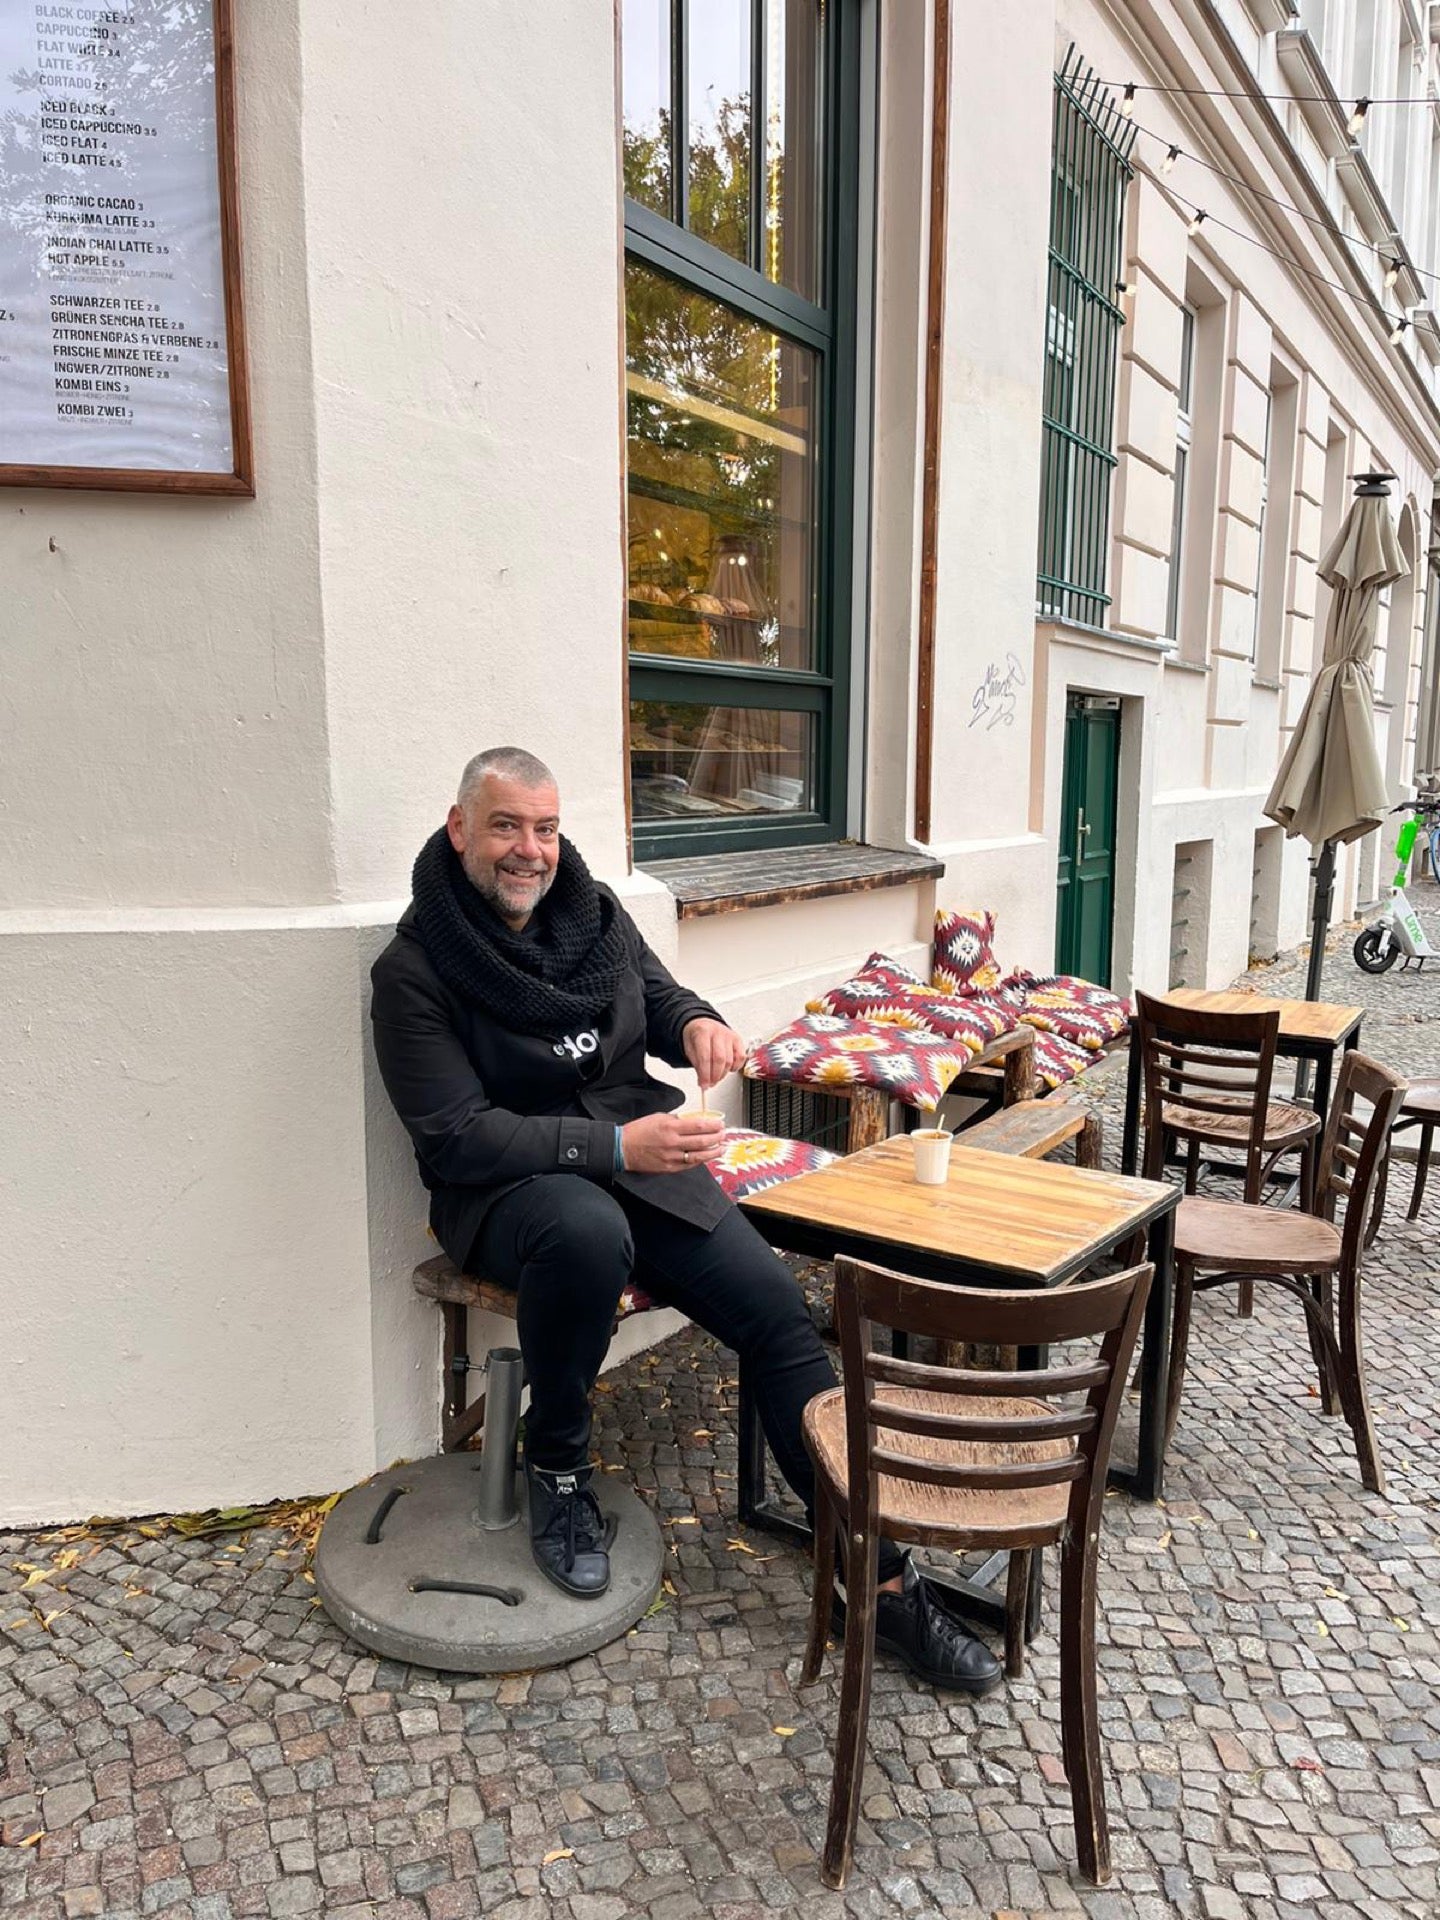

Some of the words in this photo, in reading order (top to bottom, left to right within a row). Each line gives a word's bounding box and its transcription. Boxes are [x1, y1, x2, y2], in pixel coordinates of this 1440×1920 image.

[35, 4, 74, 19] BLACK
[76, 9, 120, 24] COFFEE
[36, 22, 109, 39] CAPPUCCINO
[37, 40, 65, 53] FLAT
[67, 42, 105, 56] WHITE
[38, 57, 74, 71] LATTE
[39, 74, 92, 89] CORTADO
[41, 100, 67, 113] ICED
[70, 102, 107, 116] BLACK
[41, 118, 67, 129] ICED
[70, 119, 142, 135] CAPPUCCINO
[42, 134, 68, 147] ICED
[71, 137, 99, 149] FLAT
[43, 152, 69, 164] ICED
[72, 153, 107, 167] LATTE
[45, 194, 95, 208] ORGANIC
[97, 196, 135, 211] CACAO
[138, 203, 144, 211] 3
[46, 211, 103, 226] KURKUMA
[106, 214, 140, 228] LATTE
[47, 236, 86, 249] INDIAN
[89, 238, 116, 251] CHAI
[119, 240, 154, 254] LATTE
[48, 252, 71, 265] HOT
[73, 254, 110, 267] APPLE
[49, 294, 121, 309] SCHWARZER
[123, 298, 145, 311] TEE
[51, 310, 97, 325] GRÜNER
[99, 314, 146, 327] SENCHA
[148, 317, 169, 330] TEE
[52, 328, 139, 344] ZITRONENGRAS
[152, 335, 204, 348] VERBENE
[53, 345, 101, 358] FRISCHE
[104, 347, 140, 361] MINZE
[142, 350, 164, 362] TEE
[54, 362, 154, 378] INGWER/ZITRONE
[55, 378, 93, 391] KOMBI
[95, 380, 121, 392] EINS
[124, 384, 130, 393] 3
[57, 403, 95, 416] KOMBI
[97, 405, 126, 417] ZWEI
